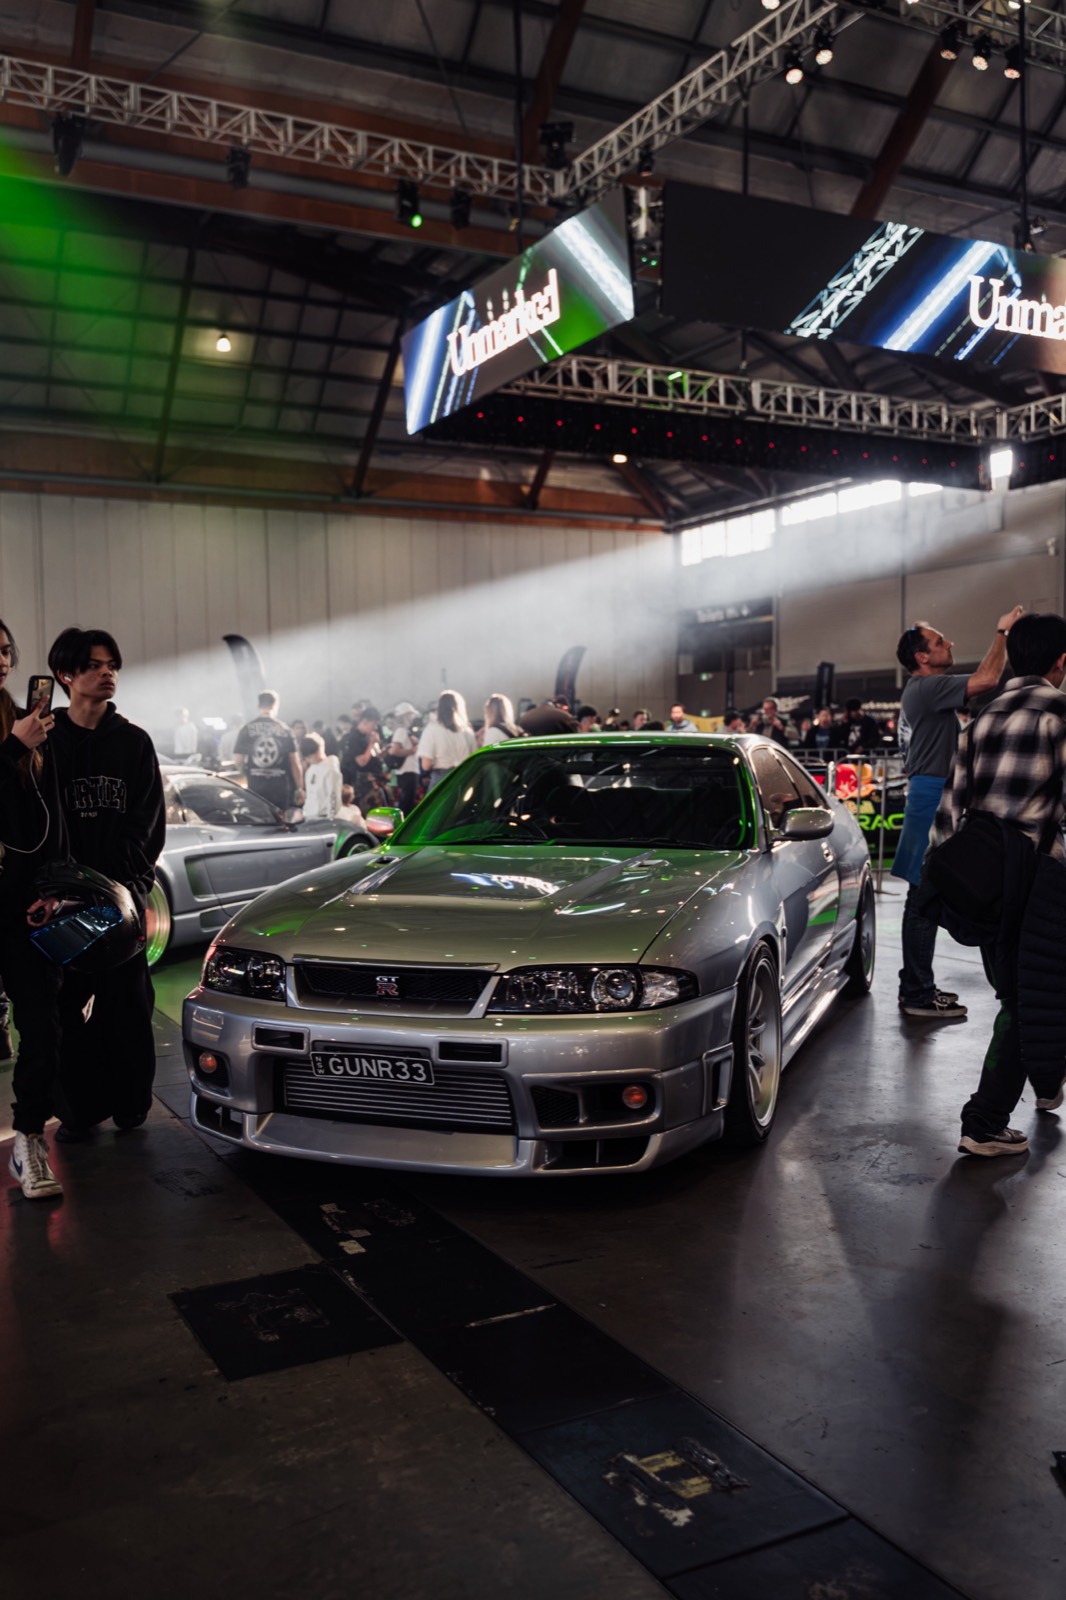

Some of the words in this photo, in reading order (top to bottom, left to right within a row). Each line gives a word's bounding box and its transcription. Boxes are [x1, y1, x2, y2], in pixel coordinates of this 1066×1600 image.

[967, 274, 1066, 341] Unma
[446, 267, 561, 377] Unmarked
[376, 975, 400, 983] GT
[376, 982, 400, 996] R
[328, 1057, 426, 1081] GUNR33
